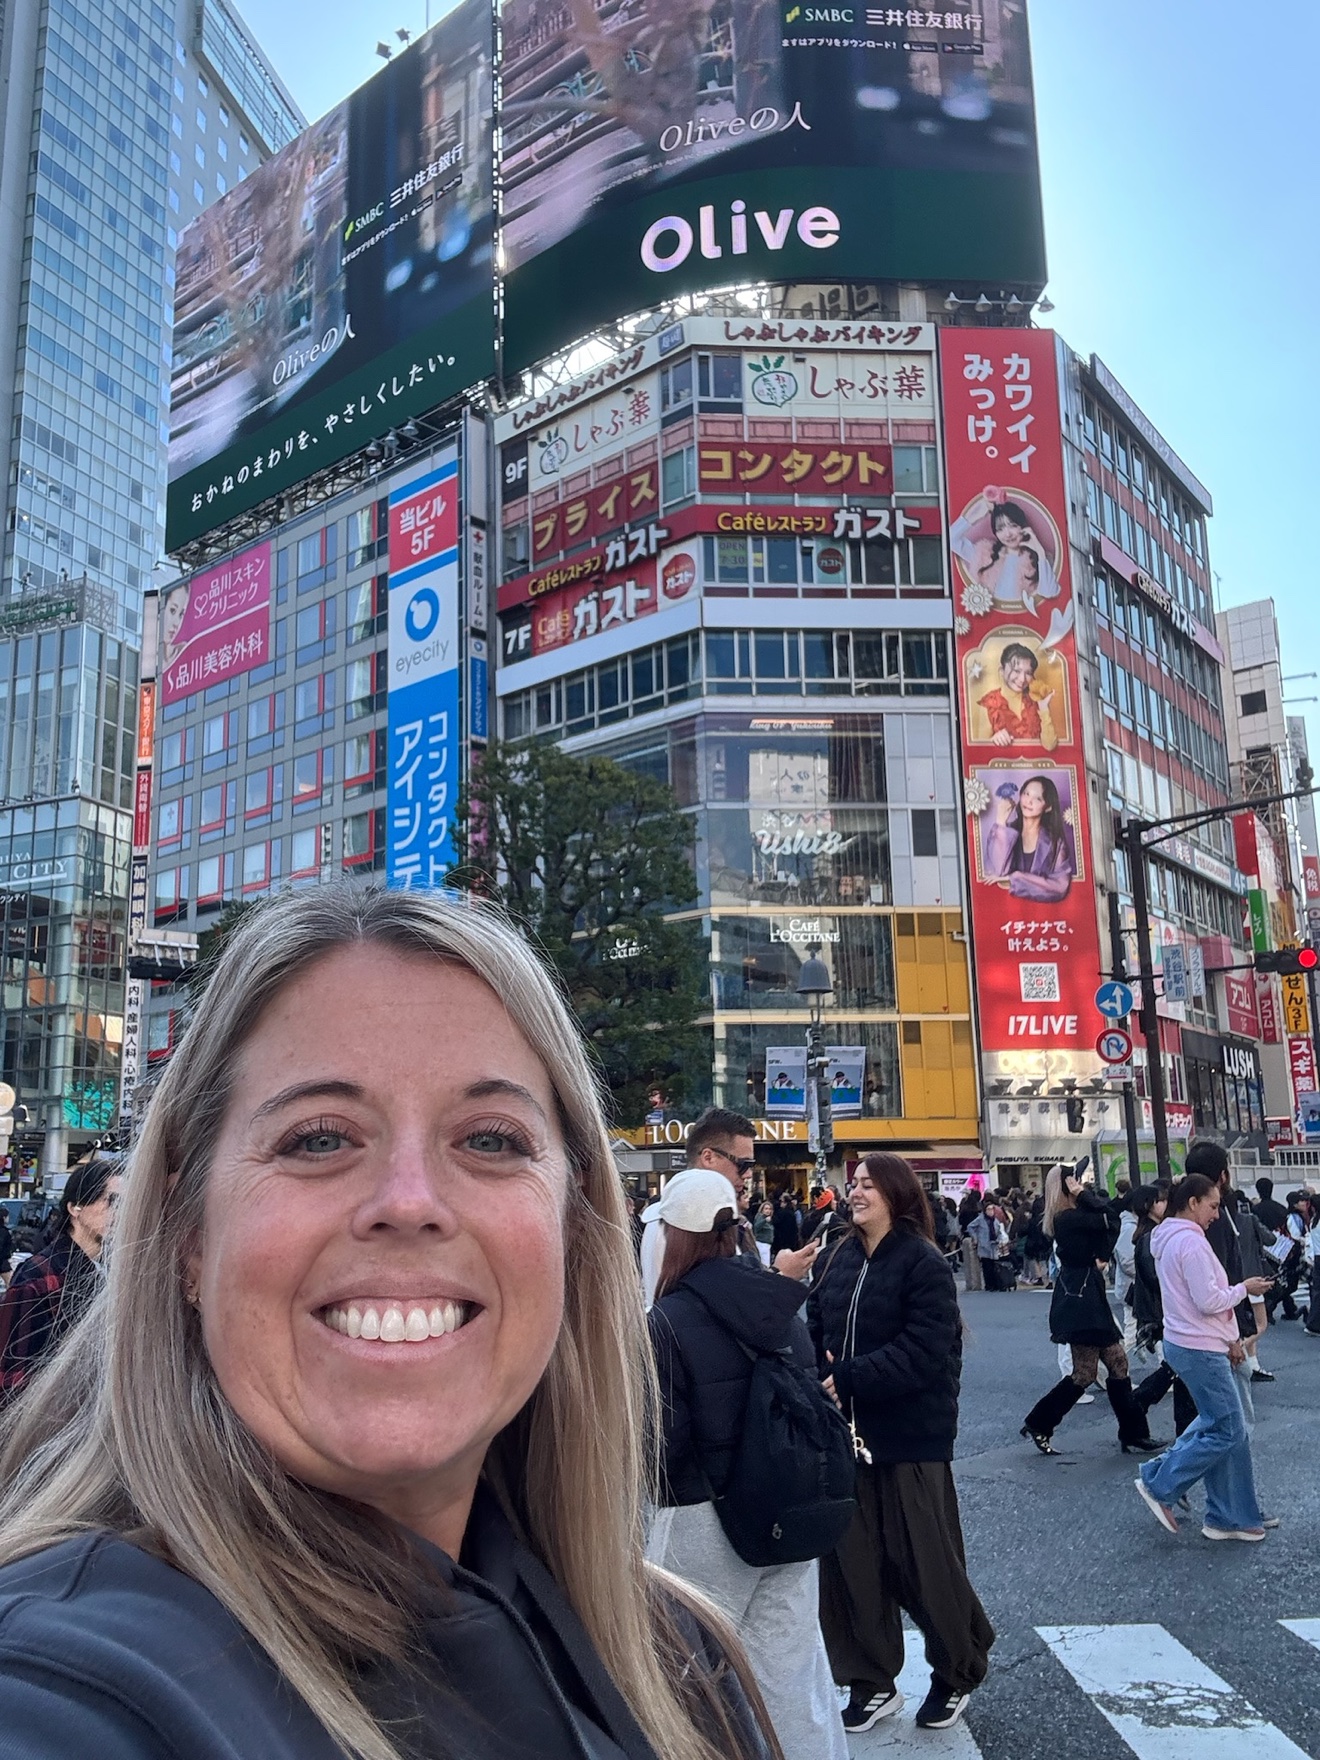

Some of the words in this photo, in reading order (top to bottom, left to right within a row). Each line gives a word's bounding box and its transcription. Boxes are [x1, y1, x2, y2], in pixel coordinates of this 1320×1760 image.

[804, 8, 854, 23] SMBC
[865, 9, 983, 30] 三井住友銀行
[659, 101, 812, 152] Oliveの人
[354, 202, 384, 232] SMBC
[389, 141, 464, 208] 三井住友銀行
[640, 199, 841, 273] Olive
[272, 314, 356, 386] Oliveの人
[723, 320, 923, 346] しゃぶしゃぶバイキング
[511, 345, 646, 430] しゃぶしゃぶバイキング
[809, 364, 926, 401] しゃぶ葉
[573, 391, 651, 453] しゃぶ葉
[1002, 353, 1037, 474] カワイイ
[505, 456, 527, 485] 9F
[700, 448, 886, 485] コンタクト
[399, 495, 447, 535] 当ビル
[535, 469, 657, 551] プライス
[833, 508, 921, 541] ガスト
[411, 524, 436, 556] 5F
[604, 521, 668, 573] ガスト
[209, 557, 265, 600] 品川スキン
[665, 571, 694, 590] ガスト
[208, 582, 258, 621] クリニック
[573, 580, 651, 640] ガスト
[396, 639, 450, 675] eyecity
[505, 624, 531, 655] 7F
[176, 628, 263, 690] 品川美容外科
[428, 711, 448, 886] コンタクト
[13, 860, 67, 879] CITY
[1234, 871, 1246, 896] 4F
[769, 929, 841, 943] L'OCCITANE
[1000, 920, 1074, 935] イチナナで、
[1007, 937, 1069, 952] 叶えよう。
[1170, 949, 1185, 997] 渋谷駅前
[128, 985, 140, 1007] 内科
[1230, 981, 1252, 1011] アコム
[1261, 999, 1274, 1029] アコム
[1008, 1014, 1078, 1036] 17LIVE
[1291, 1008, 1303, 1031] 3F
[1223, 1045, 1256, 1078] LUSH
